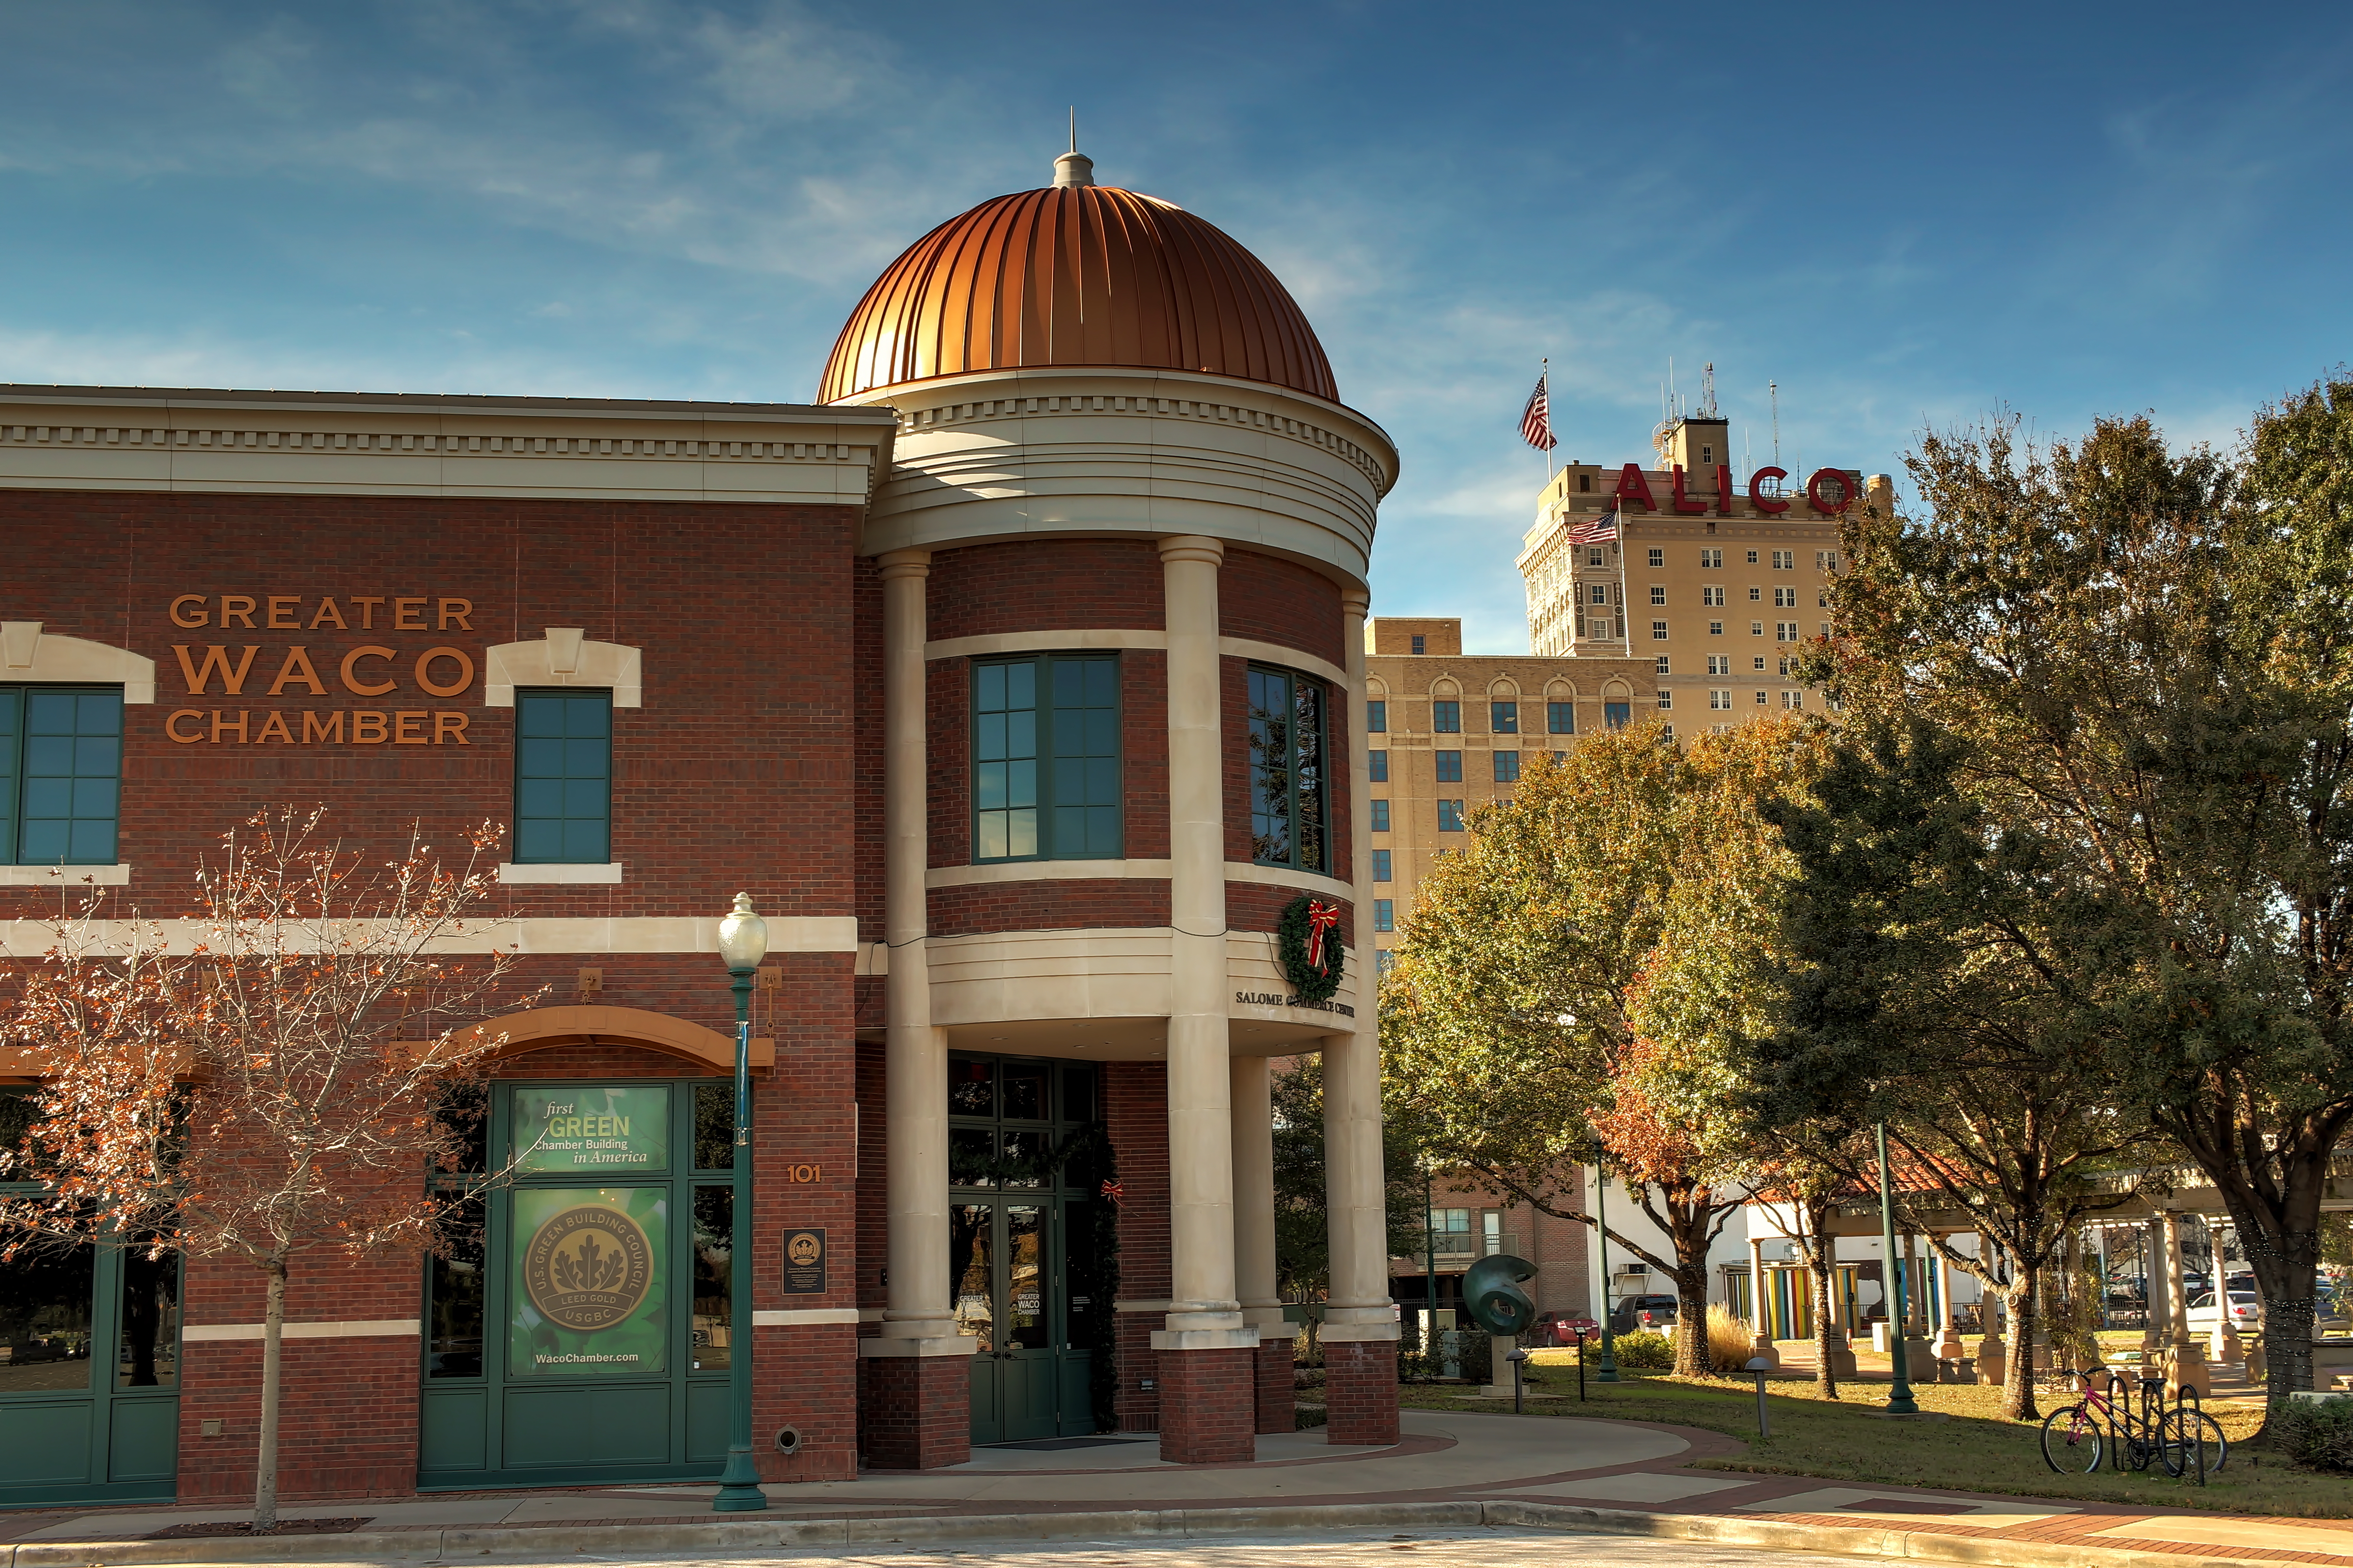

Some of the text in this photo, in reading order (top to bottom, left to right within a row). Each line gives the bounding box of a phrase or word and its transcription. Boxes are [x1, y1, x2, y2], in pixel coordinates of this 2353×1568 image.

[1611, 463, 1855, 514] ALICO
[169, 594, 474, 631] GREATER
[171, 645, 474, 696] WACO
[166, 709, 471, 745] CHAMBER
[1236, 992, 1283, 1006] SALOME
[543, 1101, 574, 1119] first
[549, 1116, 629, 1138] GREEN
[535, 1139, 628, 1151] Chamber Building
[574, 1151, 647, 1164] in America
[787, 1165, 821, 1182] 101
[535, 1213, 643, 1290] U.S. GREEN BUILDING COUNCIL
[561, 1294, 616, 1304] LEED GOLD
[565, 1309, 611, 1322] USGBC
[536, 1353, 638, 1363] WacoChamber.com
